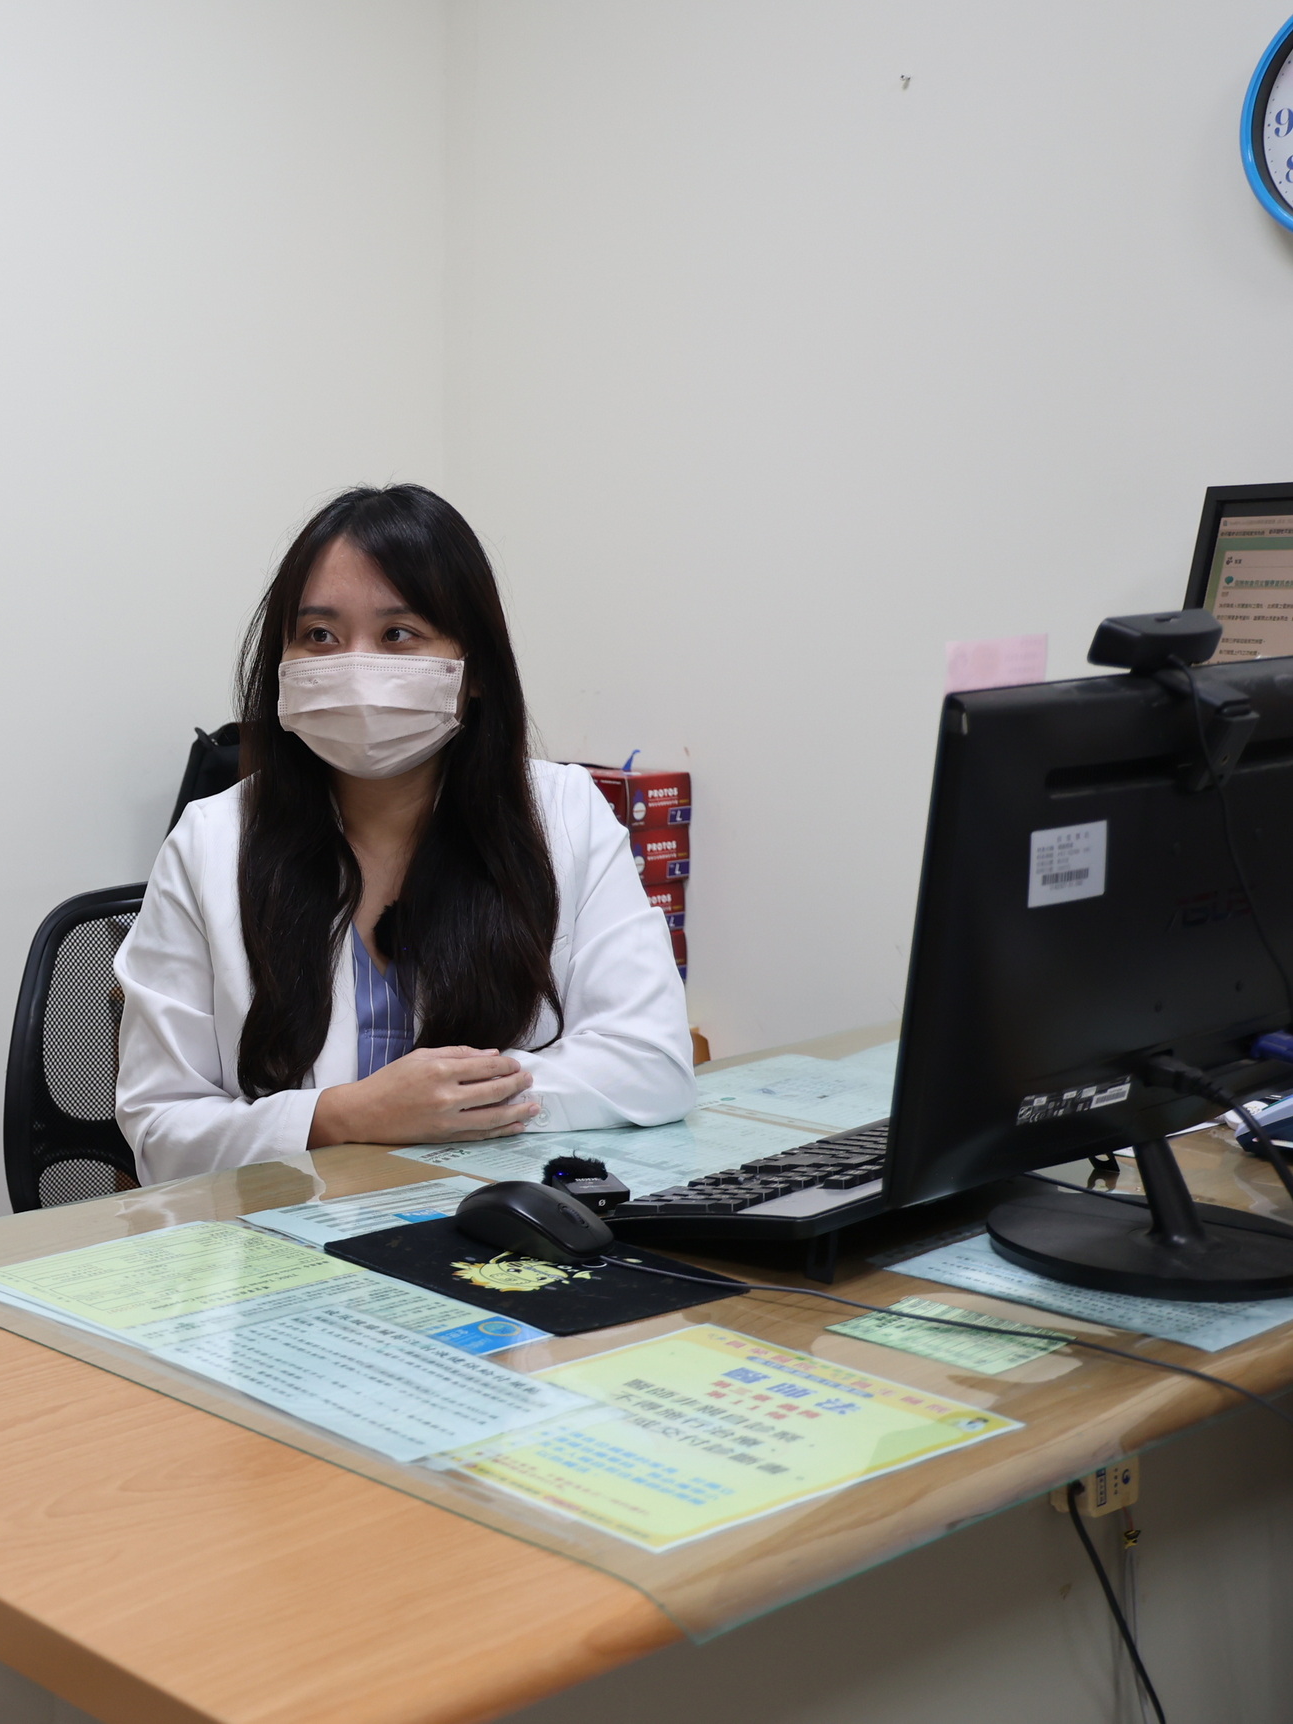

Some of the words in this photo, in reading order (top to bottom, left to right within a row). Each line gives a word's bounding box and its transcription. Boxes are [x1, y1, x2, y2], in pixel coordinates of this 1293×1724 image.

[1274, 107, 1293, 138] 9
[648, 787, 678, 798] PROTOS
[647, 840, 677, 852] PROTOS
[721, 1366, 863, 1415] 醫師法
